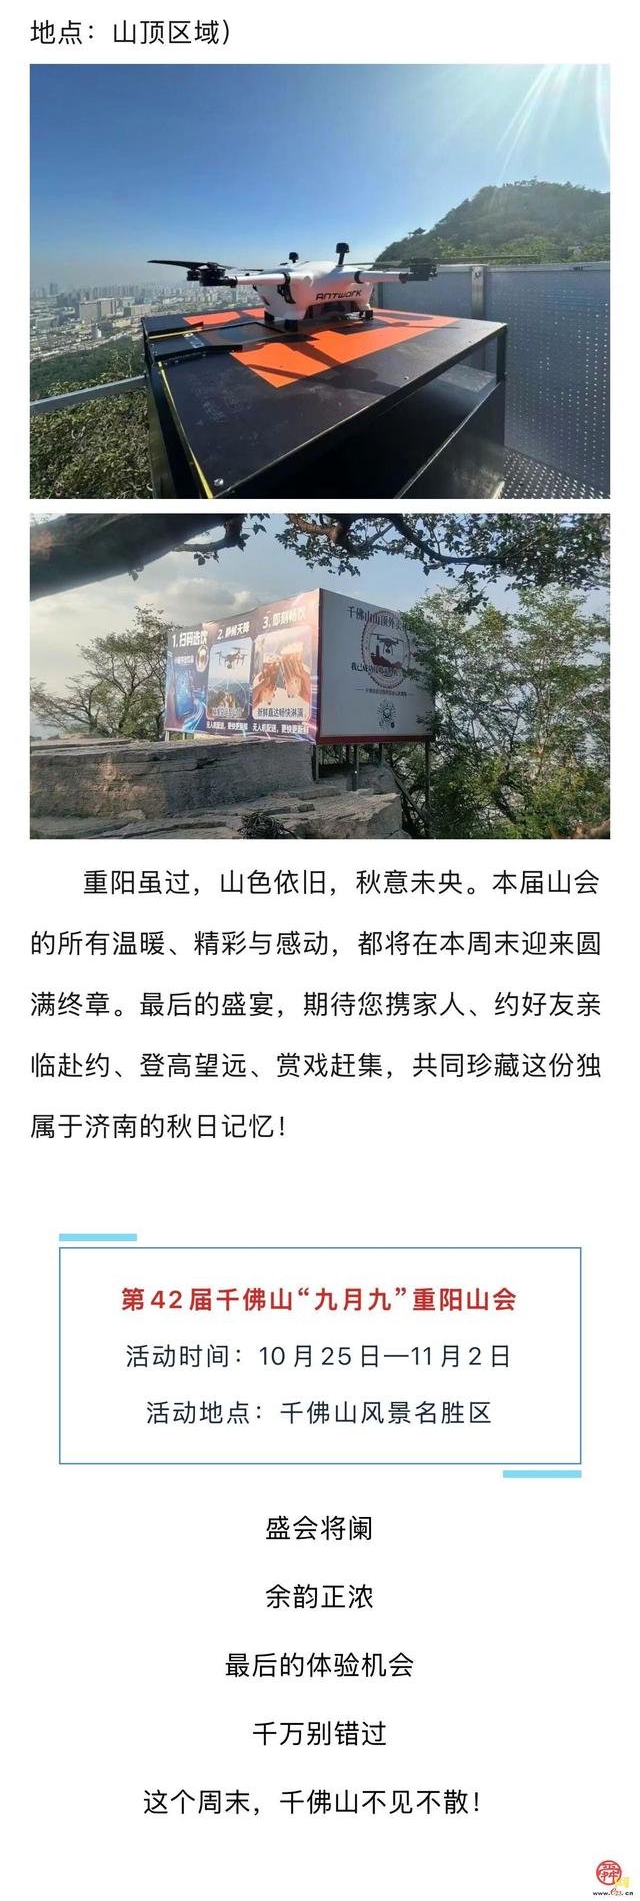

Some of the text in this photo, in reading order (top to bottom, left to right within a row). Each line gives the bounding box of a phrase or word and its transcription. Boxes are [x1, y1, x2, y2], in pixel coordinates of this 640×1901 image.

[30, 20, 233, 45] 地点：山顶区域）
[84, 869, 599, 896] 重阳虽过，山色依旧，秋意未央。本届山会
[32, 931, 600, 957] 的所有温暖、精彩与感动，都将在本周末迎来圆
[31, 991, 600, 1018] 满终章。最后的盛宴，期待您携家人、约好友亲
[32, 1052, 601, 1079] 临赴约、登高望远、赏戏赶集，共同珍藏这份独
[31, 1114, 288, 1138] 属于济南的秋日记忆！
[122, 1287, 516, 1311] 第42届千佛山“九月九”重阳山会
[147, 1401, 492, 1425] 活动地点：千佛山风景名胜区
[266, 1515, 371, 1540] 盛会将阑
[266, 1584, 373, 1608] 余韵正浓
[225, 1652, 413, 1677] 最后的体验机会
[253, 1721, 386, 1746] 千万别错过
[144, 1789, 480, 1815] 这个周末，千佛山不见不散！
